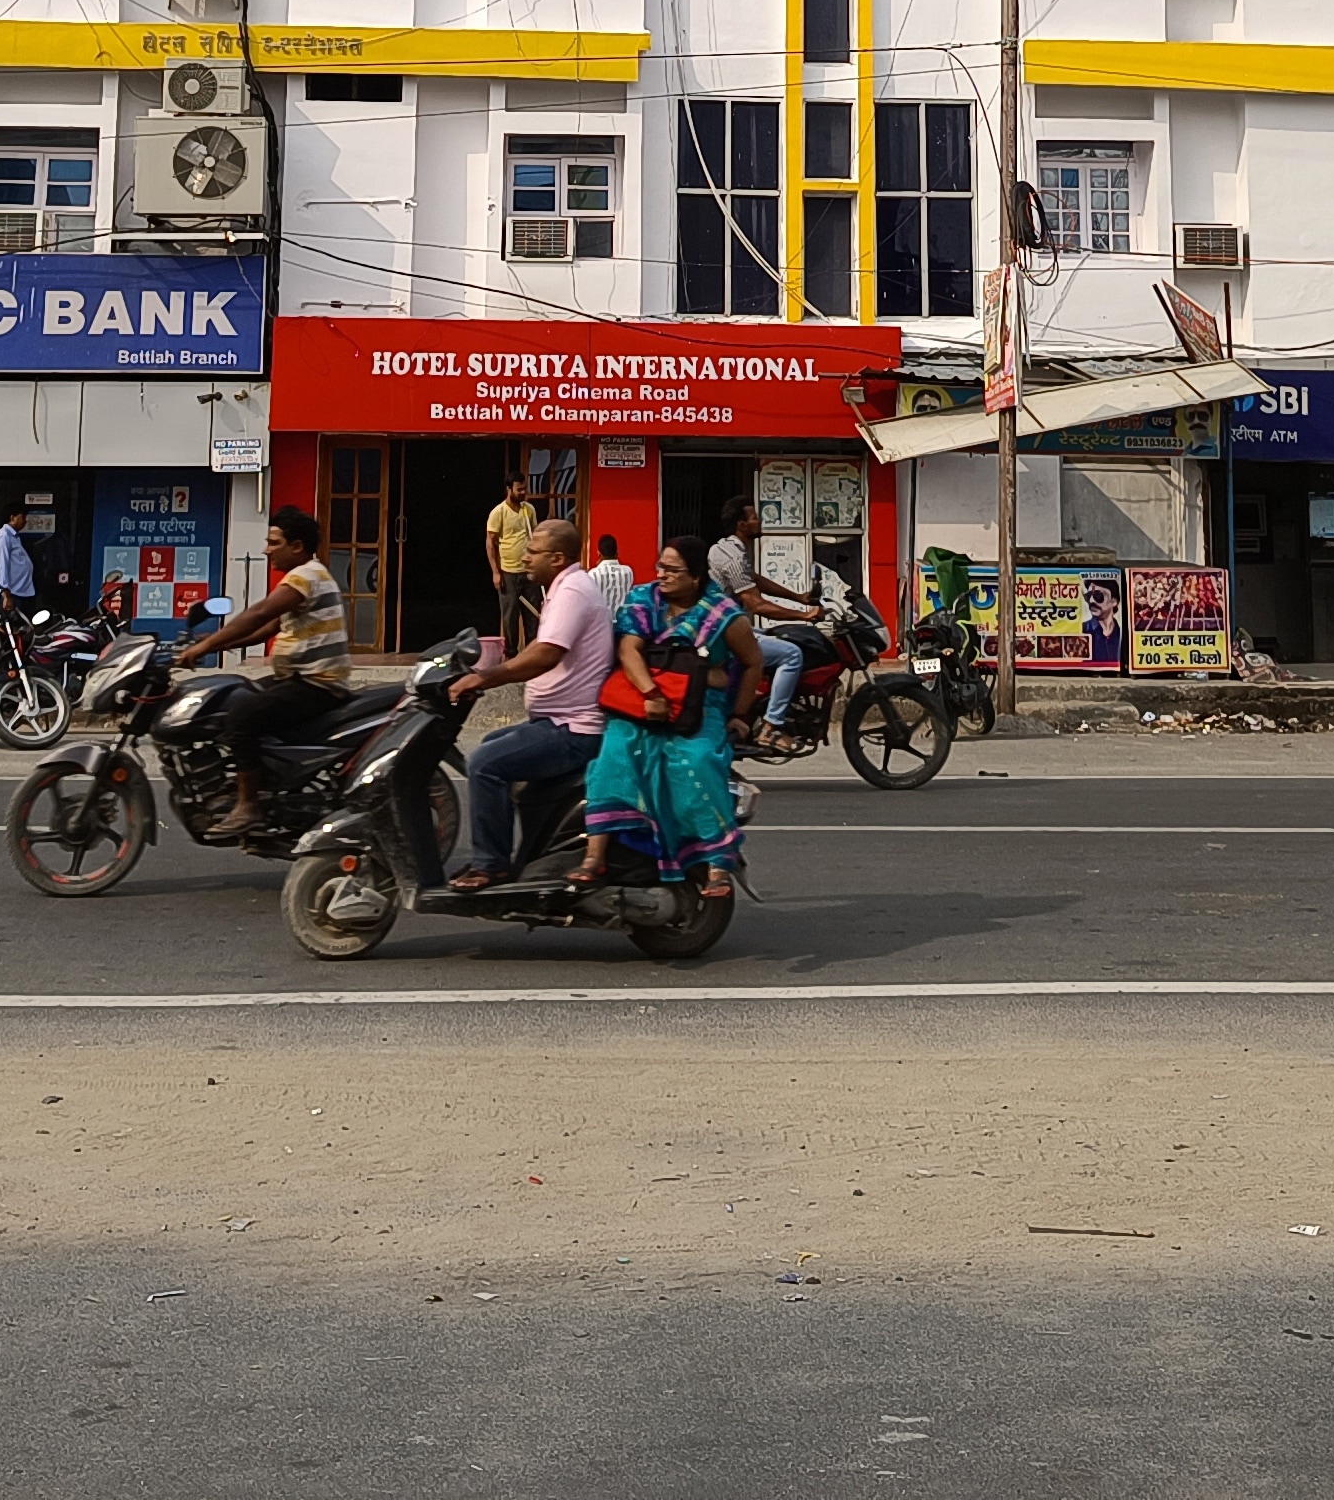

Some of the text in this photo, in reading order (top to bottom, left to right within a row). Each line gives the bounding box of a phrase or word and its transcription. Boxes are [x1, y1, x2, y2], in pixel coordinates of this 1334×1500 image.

[42, 290, 238, 336] BANK
[117, 349, 237, 365] Bettiah Branch
[371, 351, 819, 381] HOTEL SUPRIYA INTERNATIONAL
[476, 382, 689, 404] Supriya Cinema Road
[1260, 386, 1309, 415] SBI
[430, 404, 733, 426] Bettiah W. Champaran-845438
[1270, 429, 1298, 444] ATM
[130, 500, 155, 512] पता
[159, 496, 169, 514] है
[120, 517, 196, 533] कि यह एटीएम
[1049, 578, 1081, 600] होटल
[1141, 635, 1174, 647] मटन
[1137, 653, 1160, 665] 700
[1190, 650, 1222, 665] किलो
